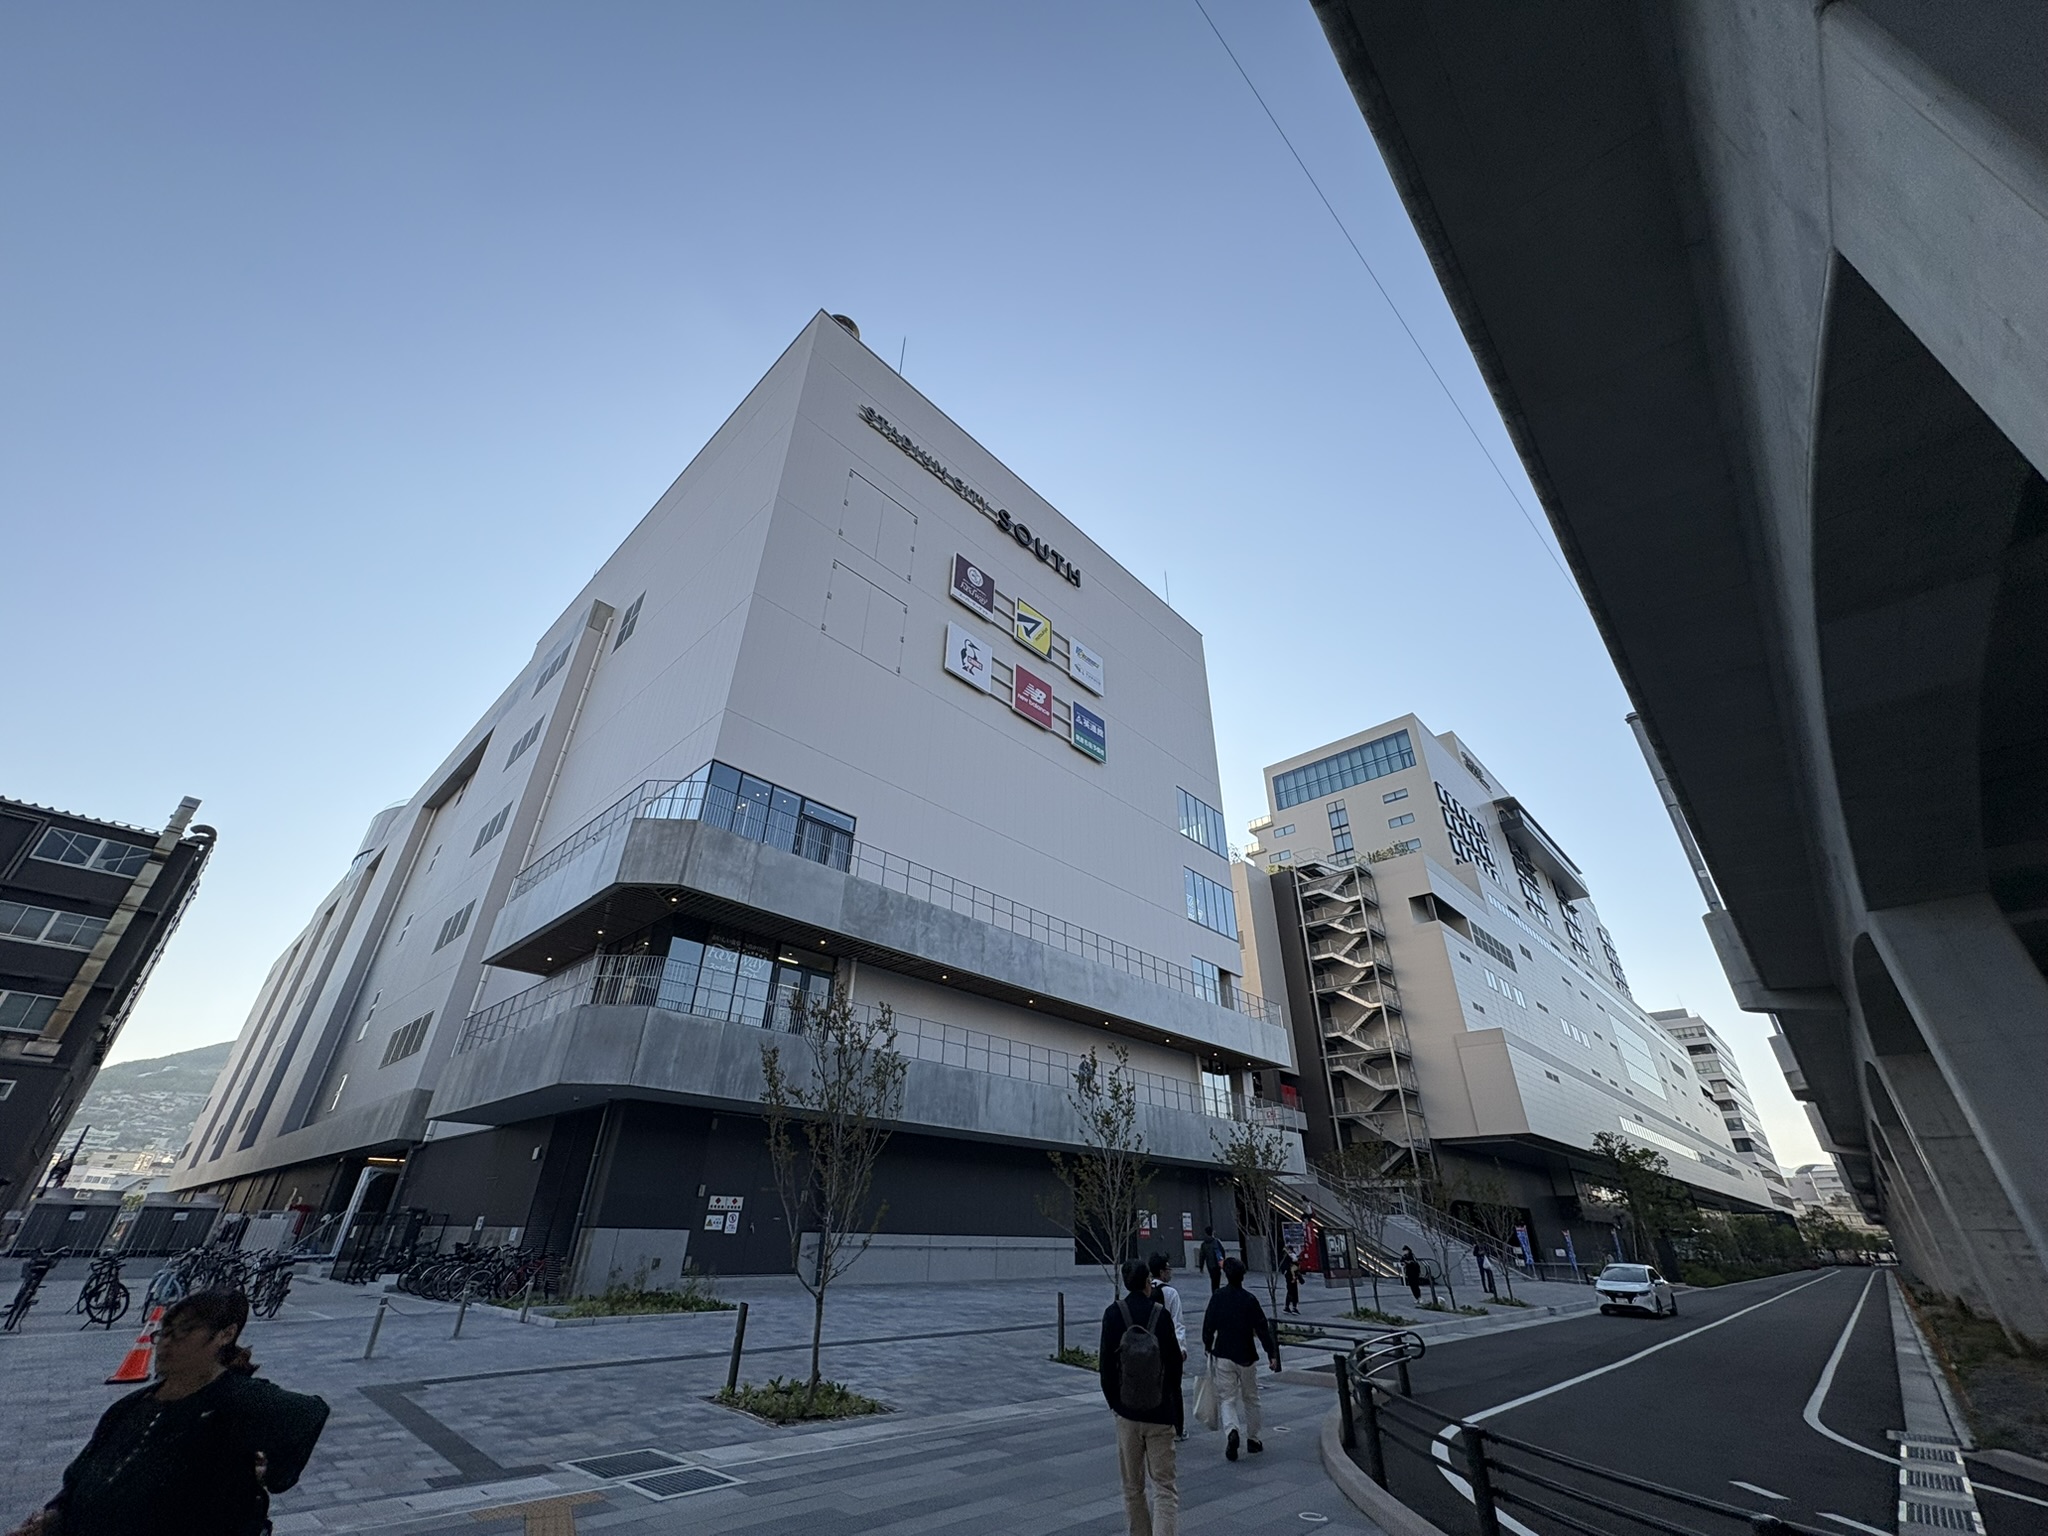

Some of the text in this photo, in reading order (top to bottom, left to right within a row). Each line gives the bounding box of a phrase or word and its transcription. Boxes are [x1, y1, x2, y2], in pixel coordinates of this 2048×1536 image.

[865, 406, 1081, 588] STADIUM CITY SOUTH
[1017, 693, 1051, 716] new balance
